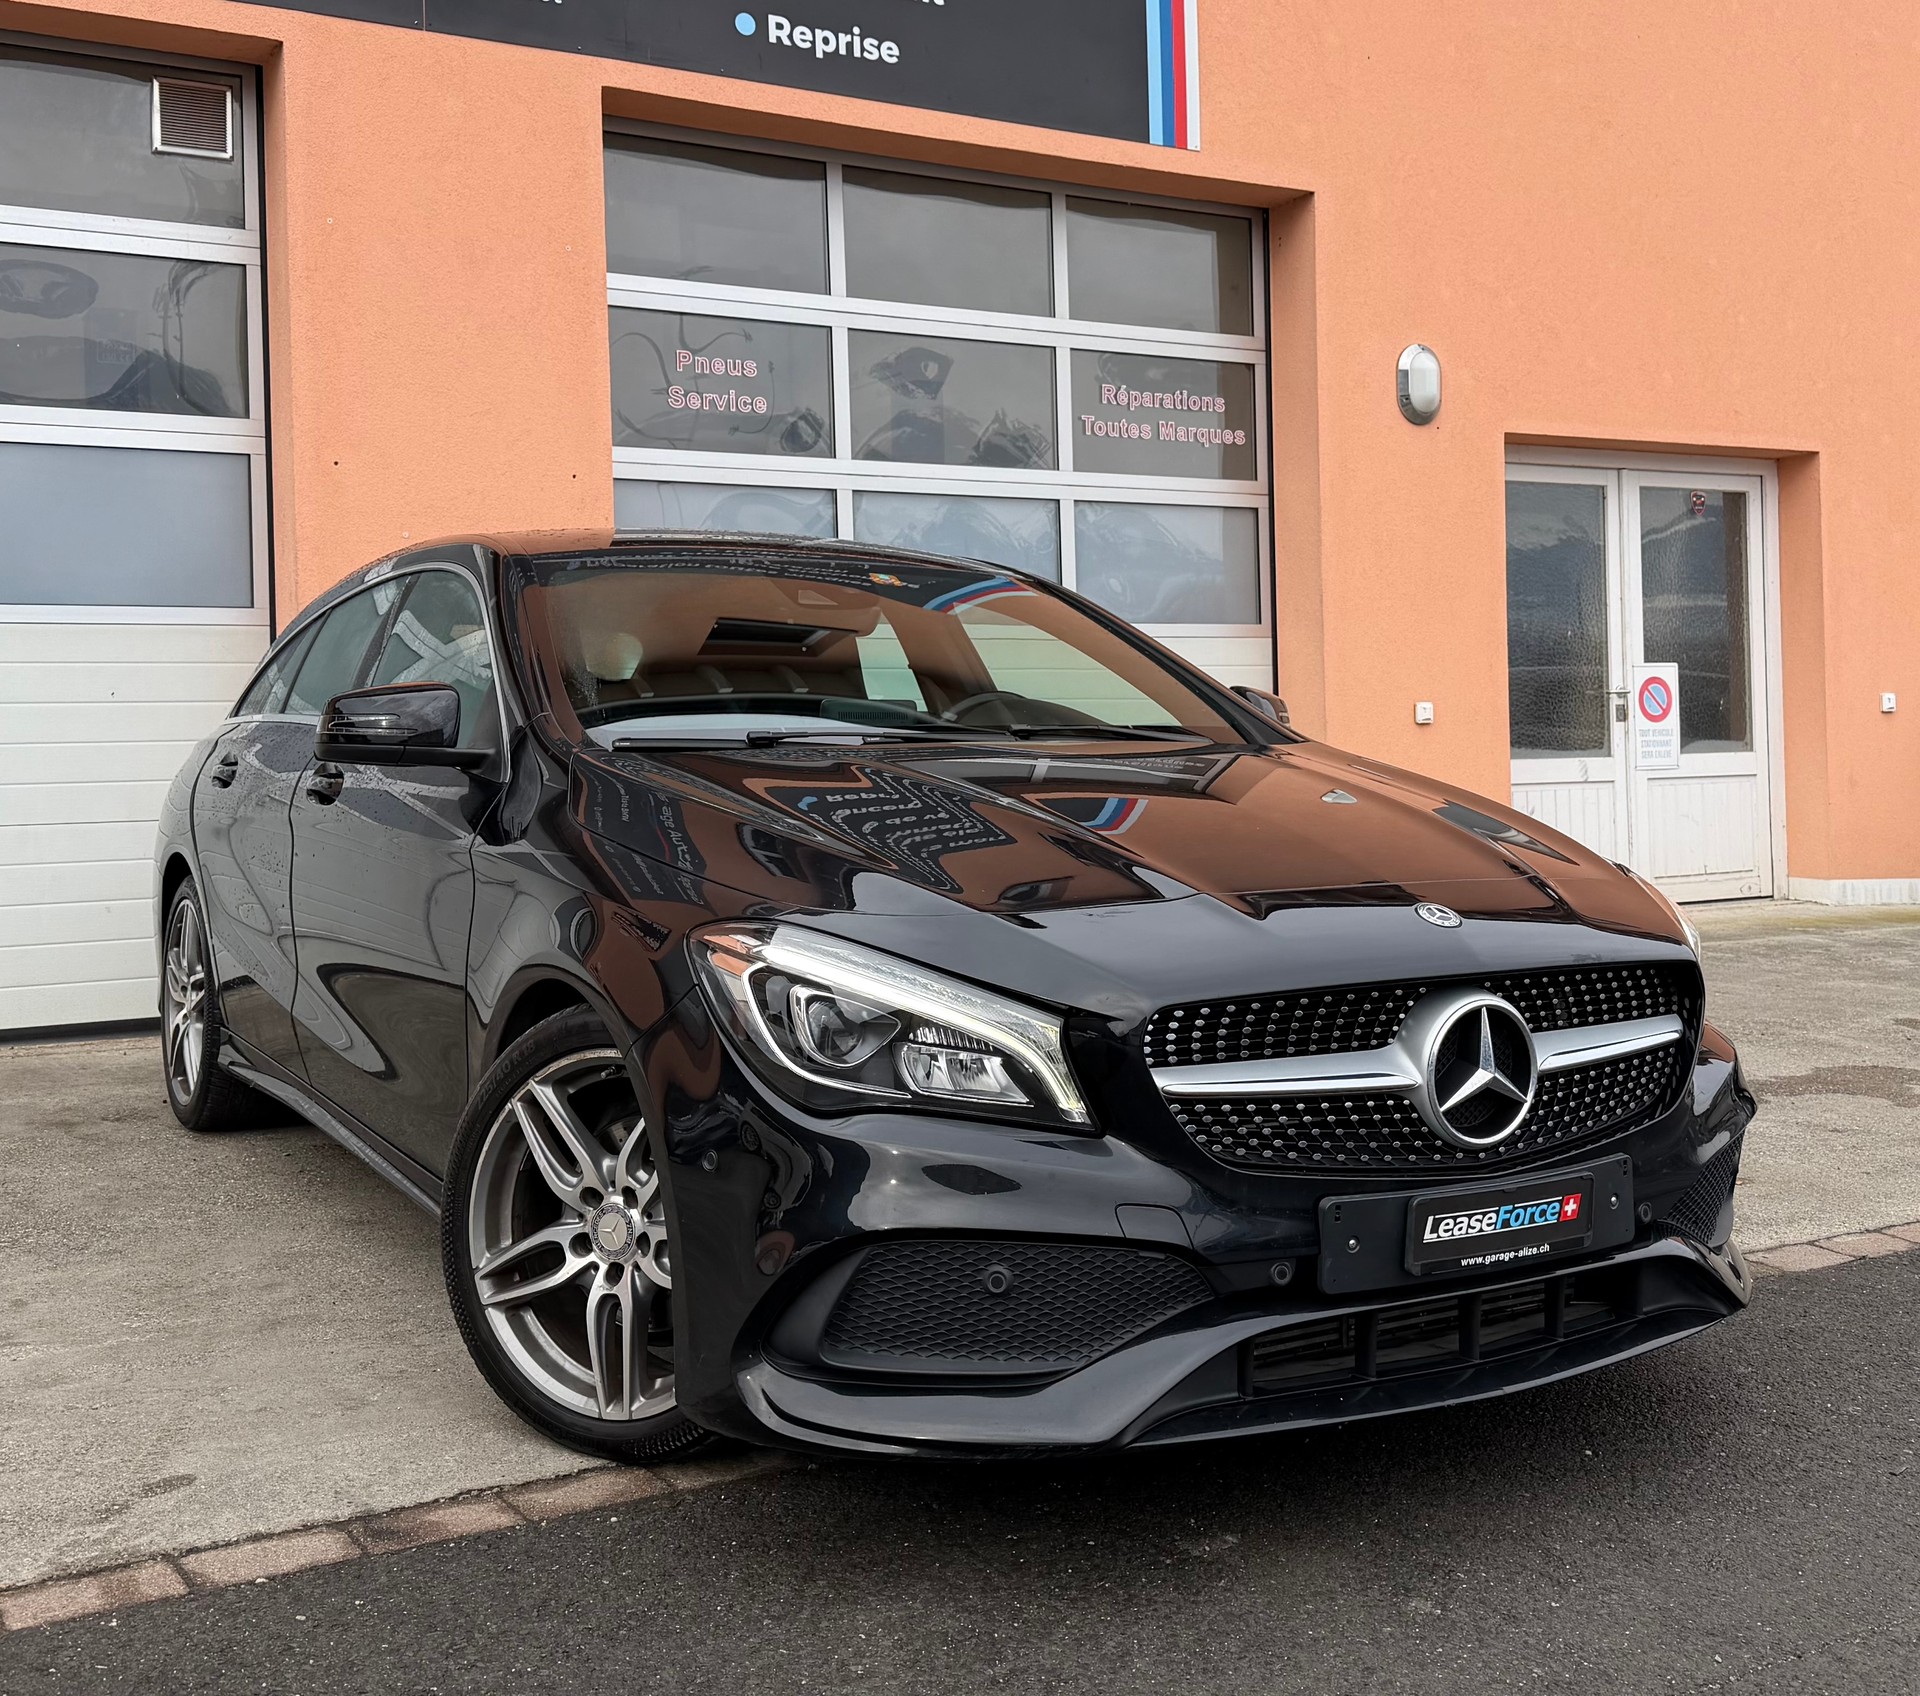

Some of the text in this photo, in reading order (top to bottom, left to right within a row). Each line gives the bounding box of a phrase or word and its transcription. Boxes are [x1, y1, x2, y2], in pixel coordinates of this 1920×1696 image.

[767, 13, 901, 64] Reprise
[676, 349, 758, 378] Pneus
[667, 385, 768, 414] Service
[1101, 383, 1226, 413] Réparations
[1081, 414, 1246, 448] Toutes Marques
[1423, 1201, 1560, 1240] LeaseForce
[1460, 1243, 1550, 1267] www.garage-alize.ch
